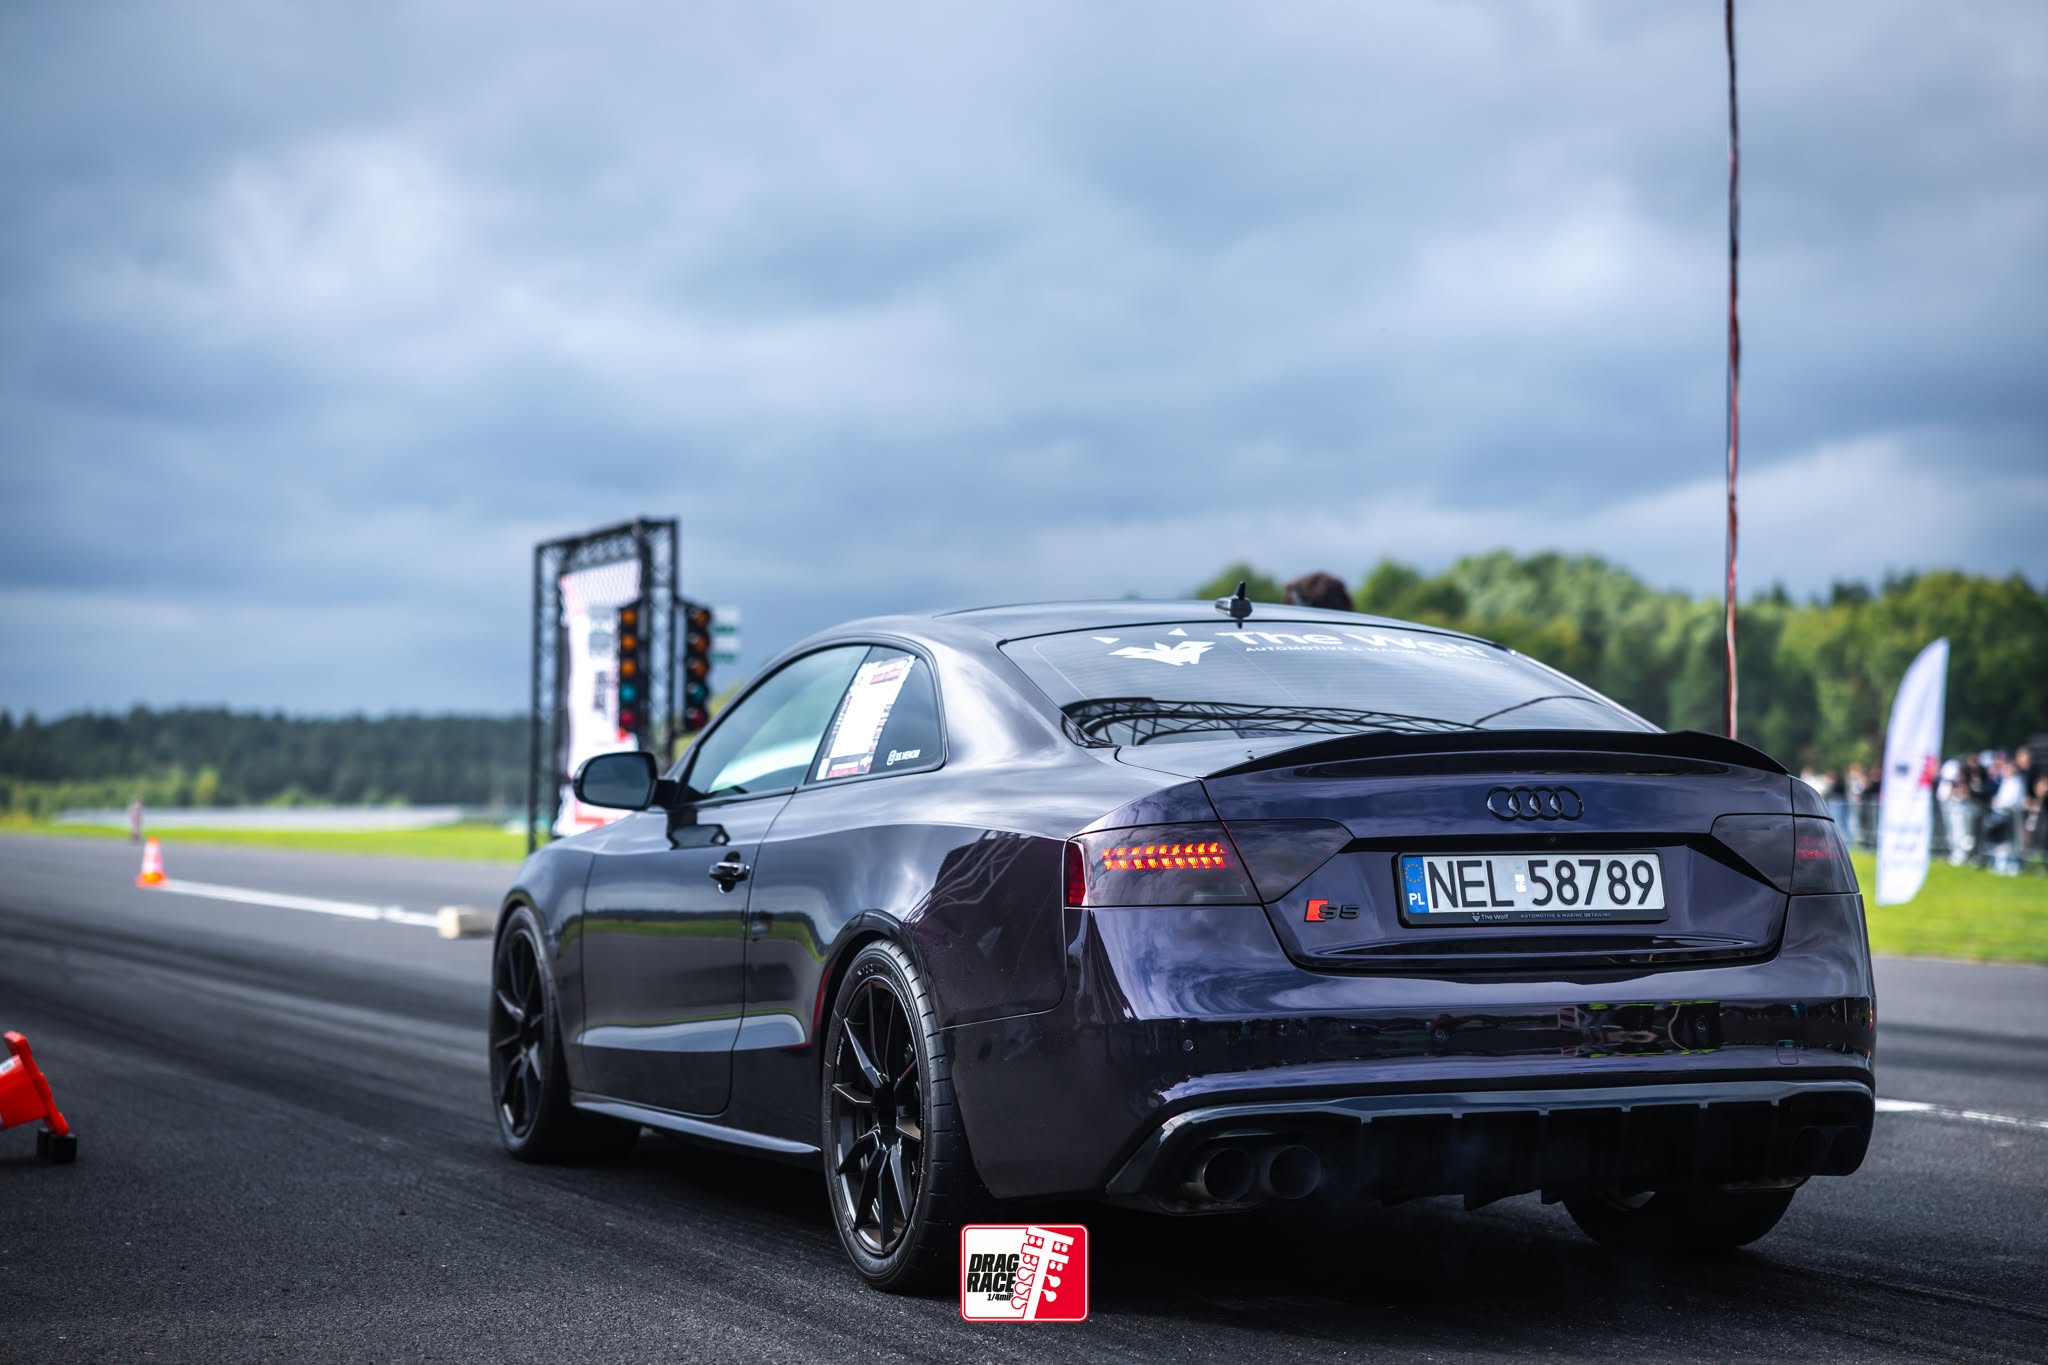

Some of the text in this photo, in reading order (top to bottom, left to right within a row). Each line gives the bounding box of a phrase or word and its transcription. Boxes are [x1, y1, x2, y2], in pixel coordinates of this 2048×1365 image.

[1215, 631, 1344, 645] The
[1341, 633, 1490, 658] Wolf
[1427, 859, 1655, 908] NEL 58789
[1408, 892, 1426, 906] PL
[1318, 903, 1360, 919] S5
[1481, 913, 1509, 921] The Wolf
